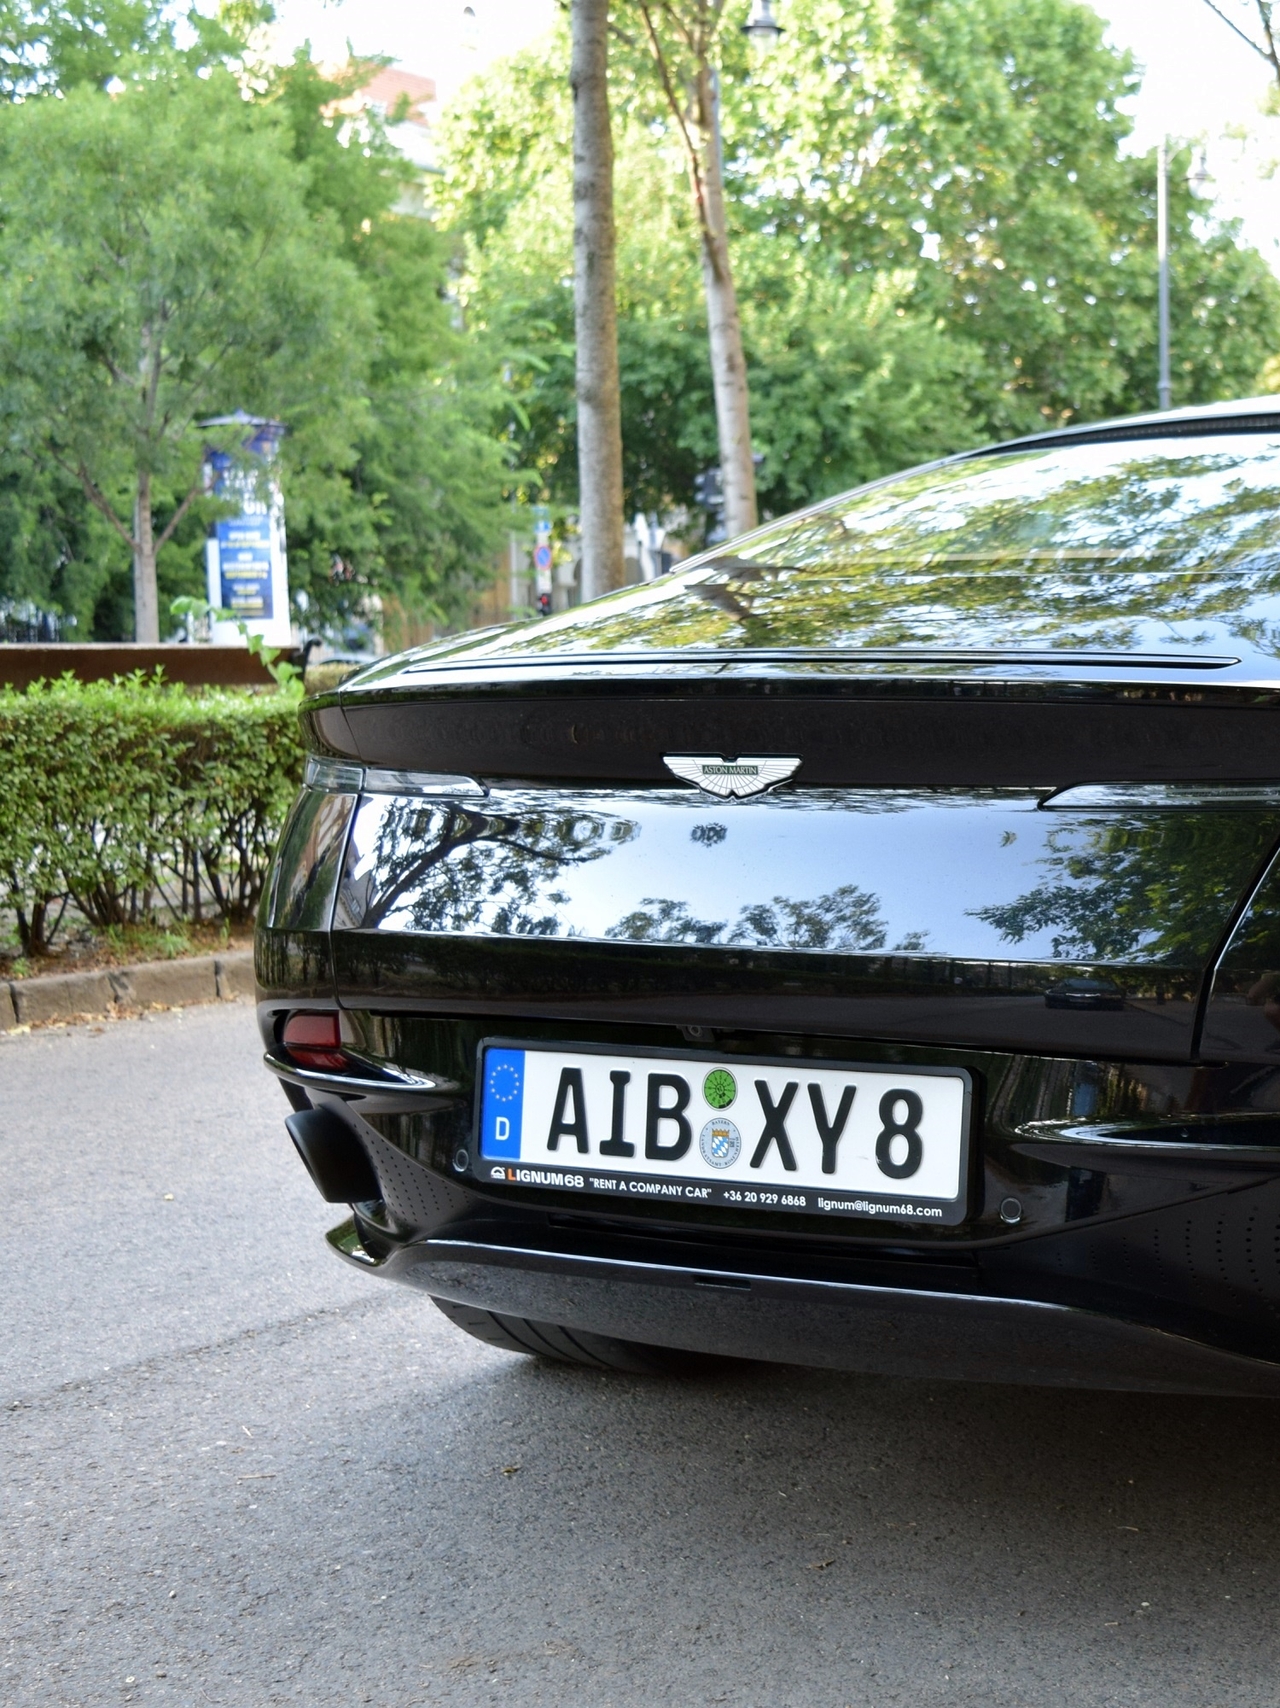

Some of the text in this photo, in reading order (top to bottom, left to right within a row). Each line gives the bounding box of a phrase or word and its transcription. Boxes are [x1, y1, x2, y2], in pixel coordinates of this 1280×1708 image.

[703, 766, 757, 774] ASTON MARTIN
[495, 1116, 510, 1141] D
[546, 1067, 692, 1160] AIB
[750, 1079, 857, 1174] XY
[875, 1088, 924, 1179] 8
[507, 1168, 943, 1217] LIGNUM68 "RENT A COMPANY CAR" +36 20 929 6868 lignum@lignum68.com
